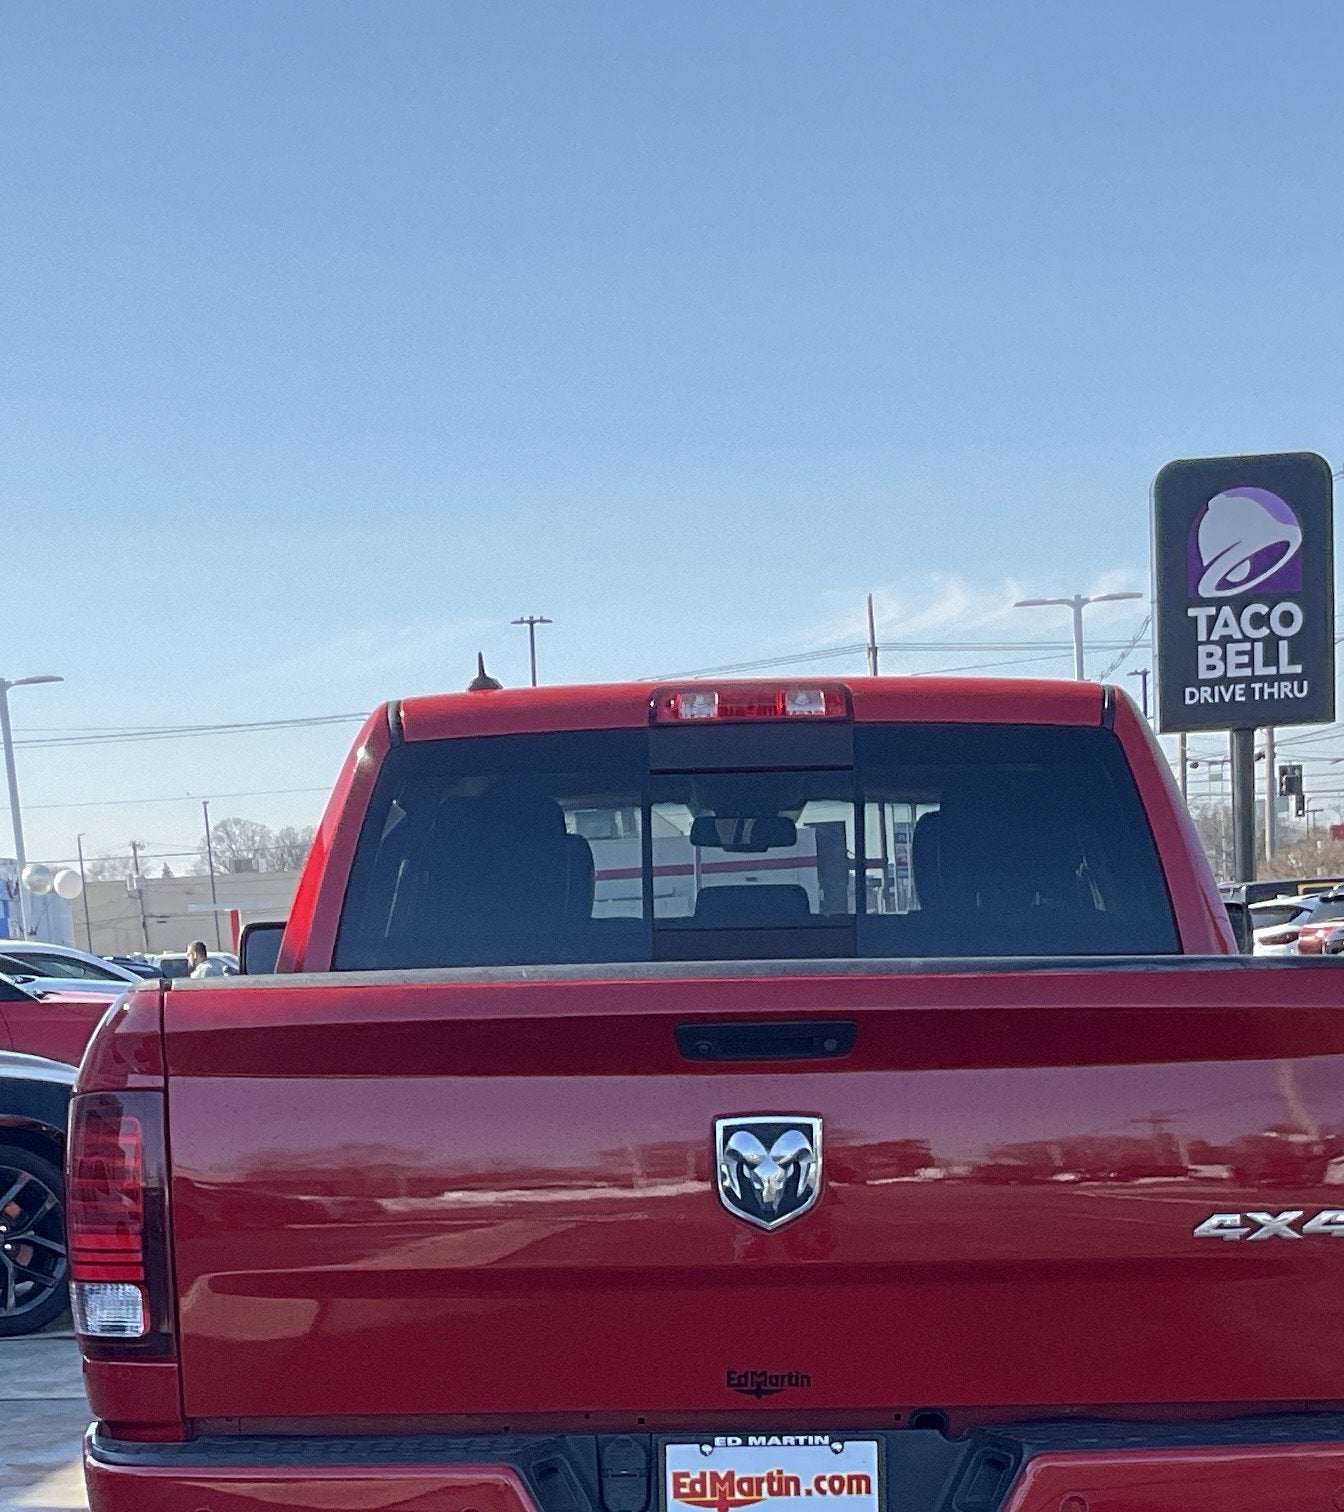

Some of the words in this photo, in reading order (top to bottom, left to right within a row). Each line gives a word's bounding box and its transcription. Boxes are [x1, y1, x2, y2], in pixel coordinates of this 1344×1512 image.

[1187, 601, 1304, 642] TACO
[1197, 639, 1303, 680] BELL
[1184, 683, 1246, 705] DRIVE
[1251, 680, 1308, 701] THRU
[714, 1436, 743, 1447] ED
[747, 1434, 830, 1446] MARTIN
